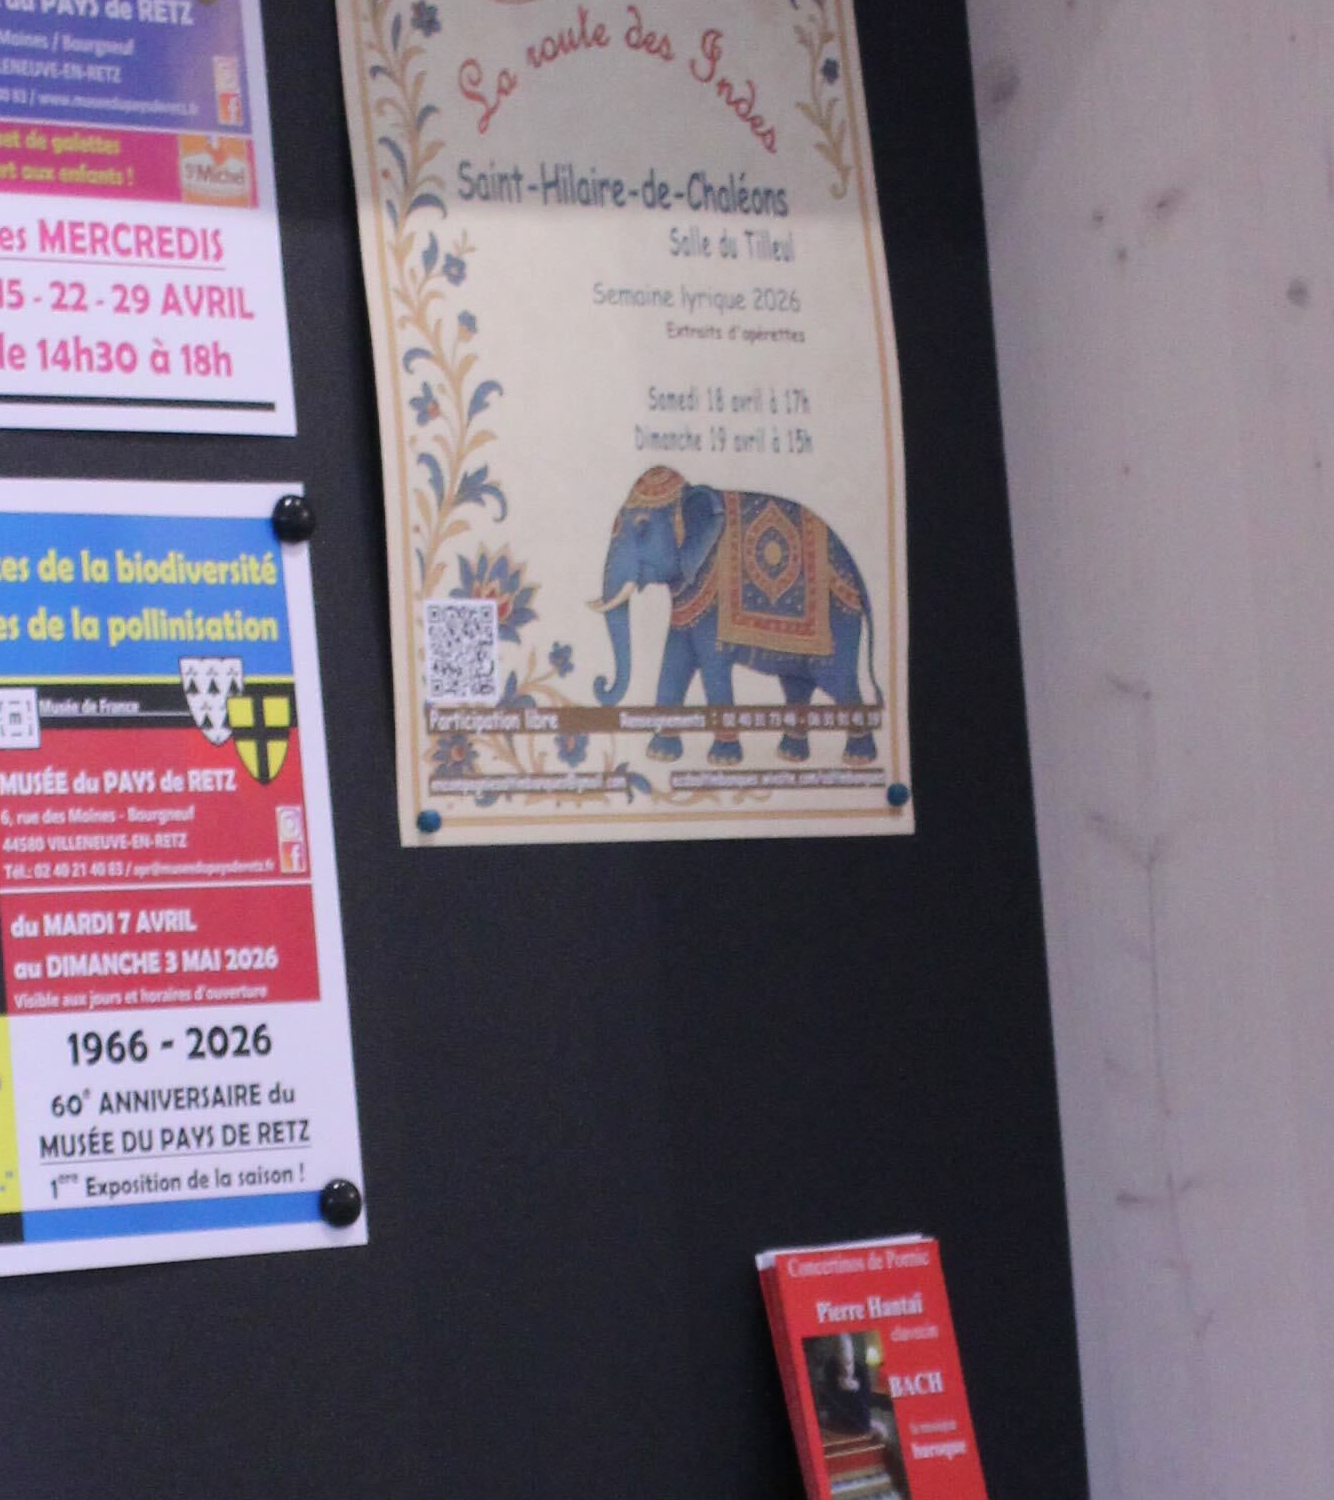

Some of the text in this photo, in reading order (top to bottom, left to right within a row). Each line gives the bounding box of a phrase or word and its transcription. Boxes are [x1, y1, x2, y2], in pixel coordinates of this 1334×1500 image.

[457, 4, 779, 155] La route des Indes
[457, 160, 789, 217] Saint-Hilaire-de-Chaléons
[38, 219, 224, 262] MERCREDIS
[669, 227, 797, 262] Salle du Tilleul
[50, 281, 88, 313] 22
[112, 283, 149, 314] 29
[162, 283, 255, 319] AVRIL
[593, 283, 802, 314] Semaine lyrique 2026
[37, 337, 137, 373] 14h30
[149, 338, 170, 374] à
[181, 341, 234, 376] 18h
[38, 549, 74, 583] de
[80, 550, 109, 583] la
[115, 550, 277, 586] biodiversité
[27, 607, 64, 642] de
[71, 607, 99, 642] la
[107, 607, 279, 646] pollinisation
[73, 772, 99, 794] du
[104, 771, 156, 793] PAYS
[161, 771, 185, 793] de
[189, 768, 237, 792] RETZ
[11, 909, 197, 938] du MARDI 7 AVRIL
[14, 947, 278, 979] au DIMANCHE 3 MAI 2026
[67, 1024, 272, 1066] 1966 2026
[99, 1083, 261, 1114] ANNIVERSAIRE
[269, 1082, 295, 1104] du
[40, 1119, 310, 1158] MUSÉE DU PAYS DE RETZ
[816, 1291, 923, 1324] Pierre Hantaï
[888, 1371, 944, 1398] BACH
